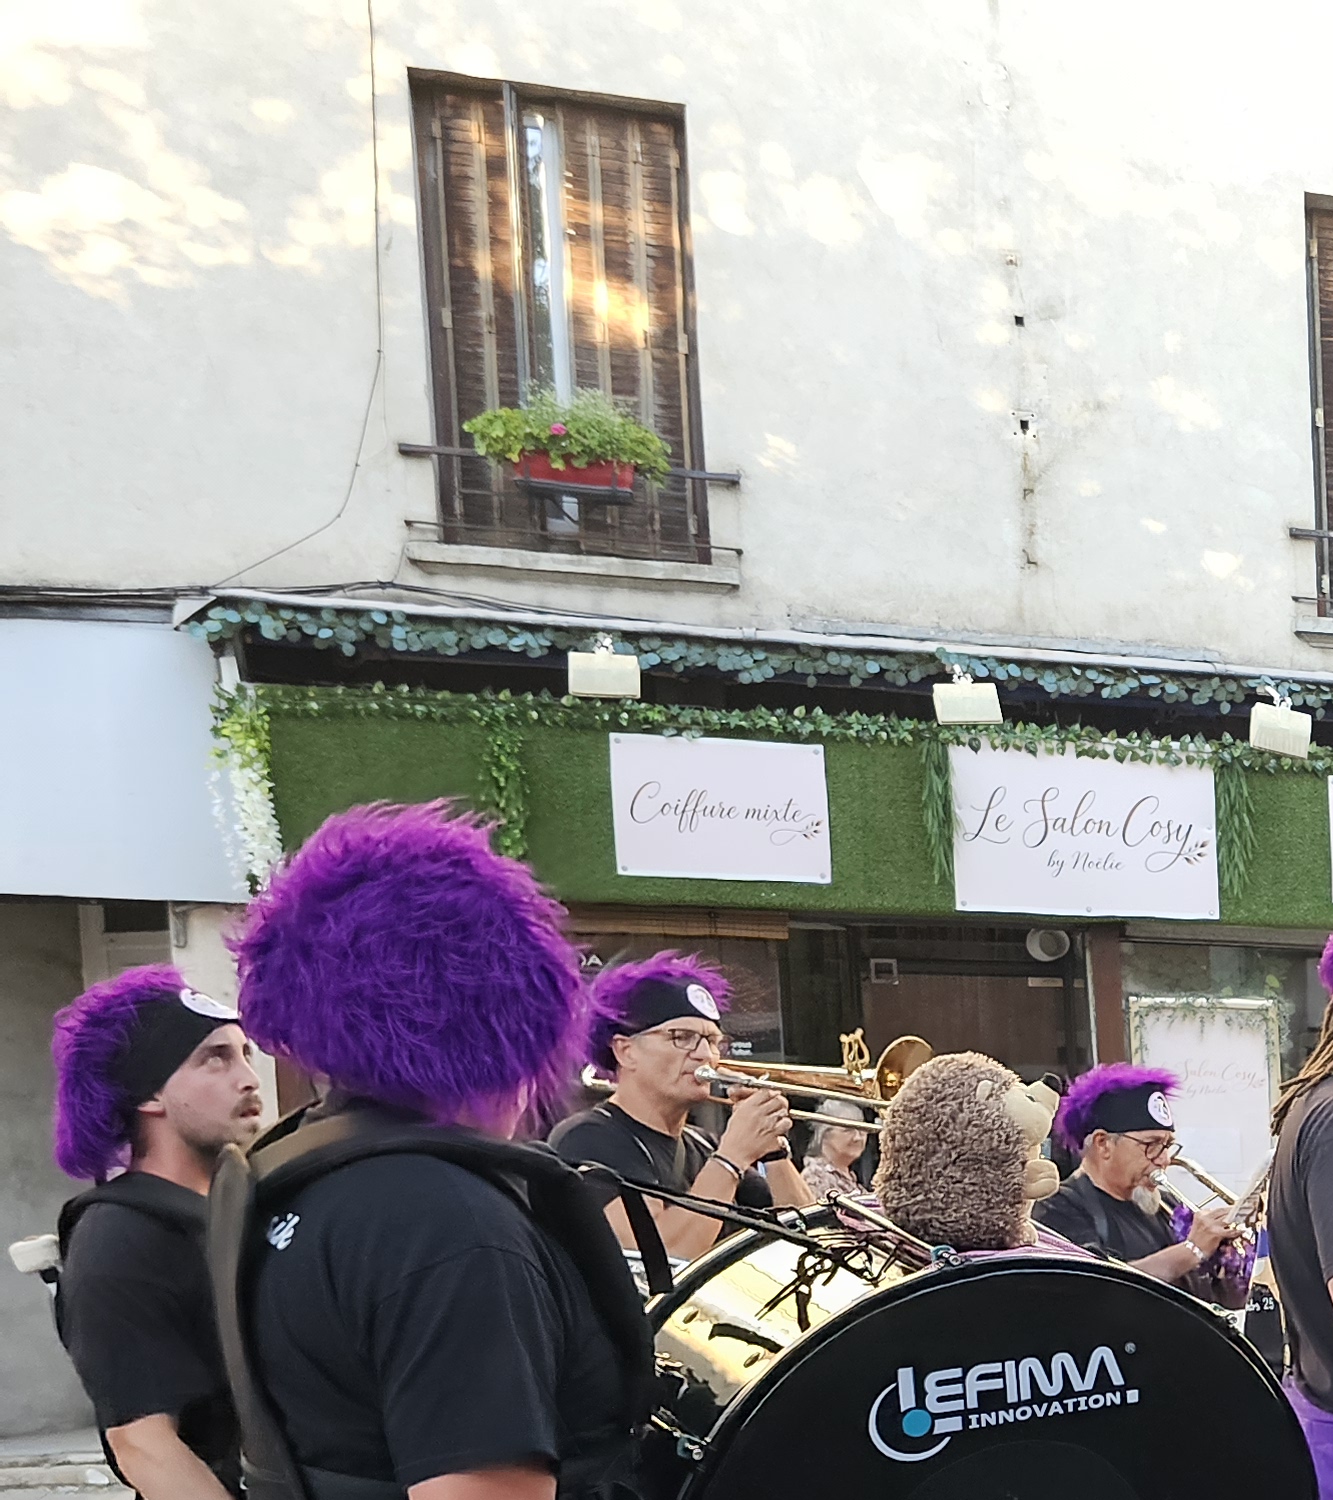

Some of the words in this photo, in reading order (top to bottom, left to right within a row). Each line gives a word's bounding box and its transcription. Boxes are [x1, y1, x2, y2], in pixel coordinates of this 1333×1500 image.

[630, 780, 738, 833] Coiffure
[745, 794, 815, 826] mixte
[963, 785, 1013, 844] Le
[1023, 786, 1119, 850] Salon
[1122, 794, 1193, 850] Cosy
[1046, 850, 1067, 878] by
[1262, 1297, 1275, 1311] 25
[968, 1389, 1122, 1430] INNOVATION
